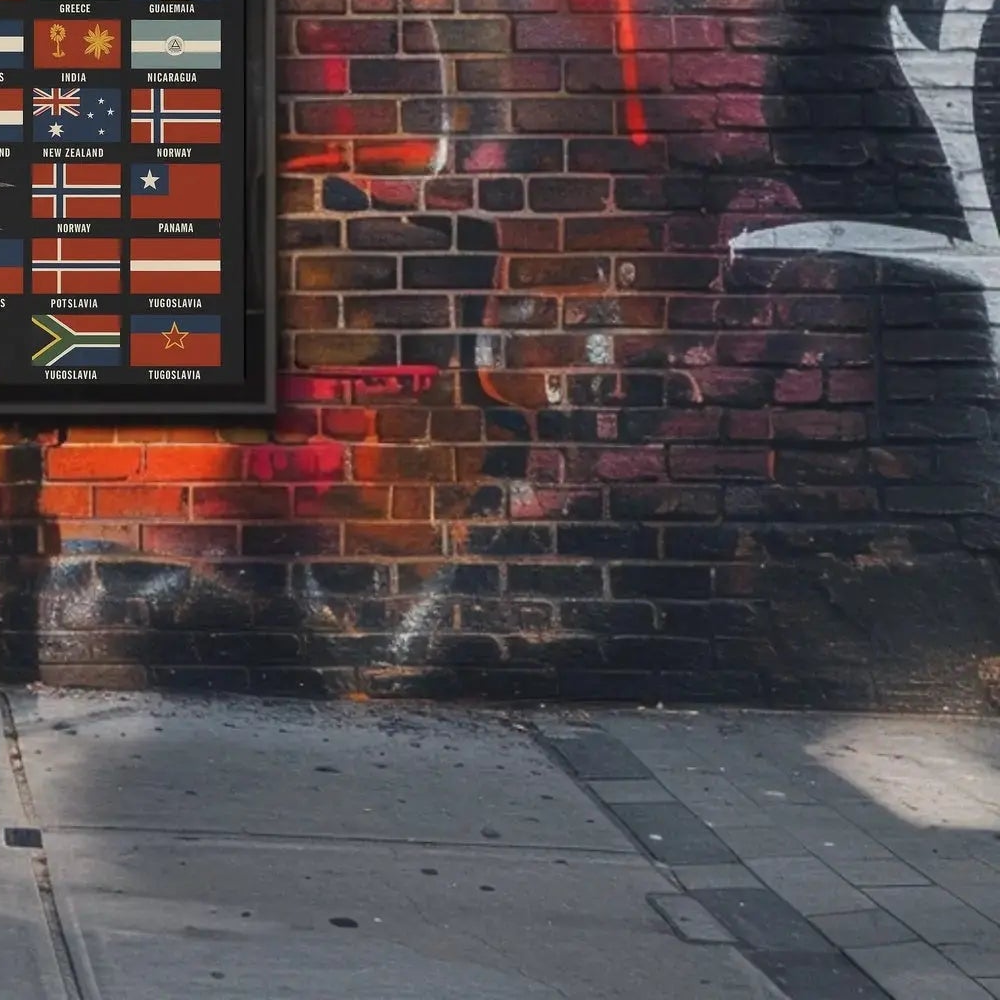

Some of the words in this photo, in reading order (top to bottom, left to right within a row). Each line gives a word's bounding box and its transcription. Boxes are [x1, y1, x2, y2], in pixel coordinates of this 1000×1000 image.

[59, 3, 91, 14] GREECE
[61, 72, 87, 83] INDIA
[147, 72, 197, 83] NICARAGUA
[42, 147, 62, 158] NEW
[64, 147, 104, 158] ZEALAND
[156, 147, 192, 158] NORWAY
[57, 223, 92, 233] NORWAY
[158, 222, 194, 233] PANAMA
[148, 298, 202, 308] YUGOSLAVIA
[44, 369, 98, 380] YUGOSLAVIA
